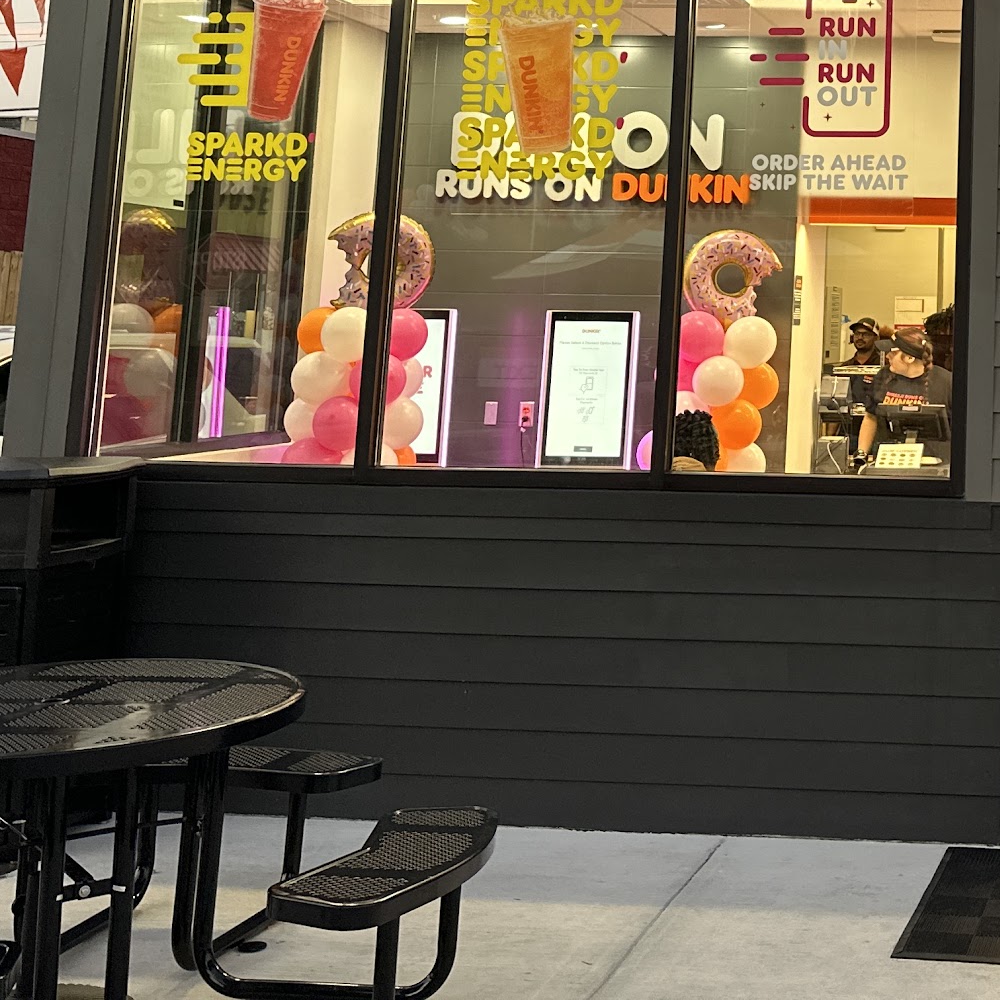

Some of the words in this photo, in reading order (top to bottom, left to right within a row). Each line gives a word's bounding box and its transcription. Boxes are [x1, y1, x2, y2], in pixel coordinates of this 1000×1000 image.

[819, 16, 877, 38] RUN
[818, 39, 848, 61] IN
[462, 50, 628, 82] SPKD'
[817, 62, 876, 84] RUN
[460, 83, 618, 114] ENGY
[816, 85, 878, 107] OUT
[187, 131, 316, 158] SPARKD'
[184, 157, 308, 183] ENERGY
[456, 149, 616, 181] ENERGY
[751, 153, 825, 172] ORDER
[830, 154, 907, 172] AHEAD
[435, 168, 532, 201] RUNS
[544, 171, 603, 203] ON
[611, 171, 750, 205] DUKIN
[748, 173, 797, 192] SKIP
[802, 173, 846, 192] THE
[851, 174, 909, 192] WAIT
